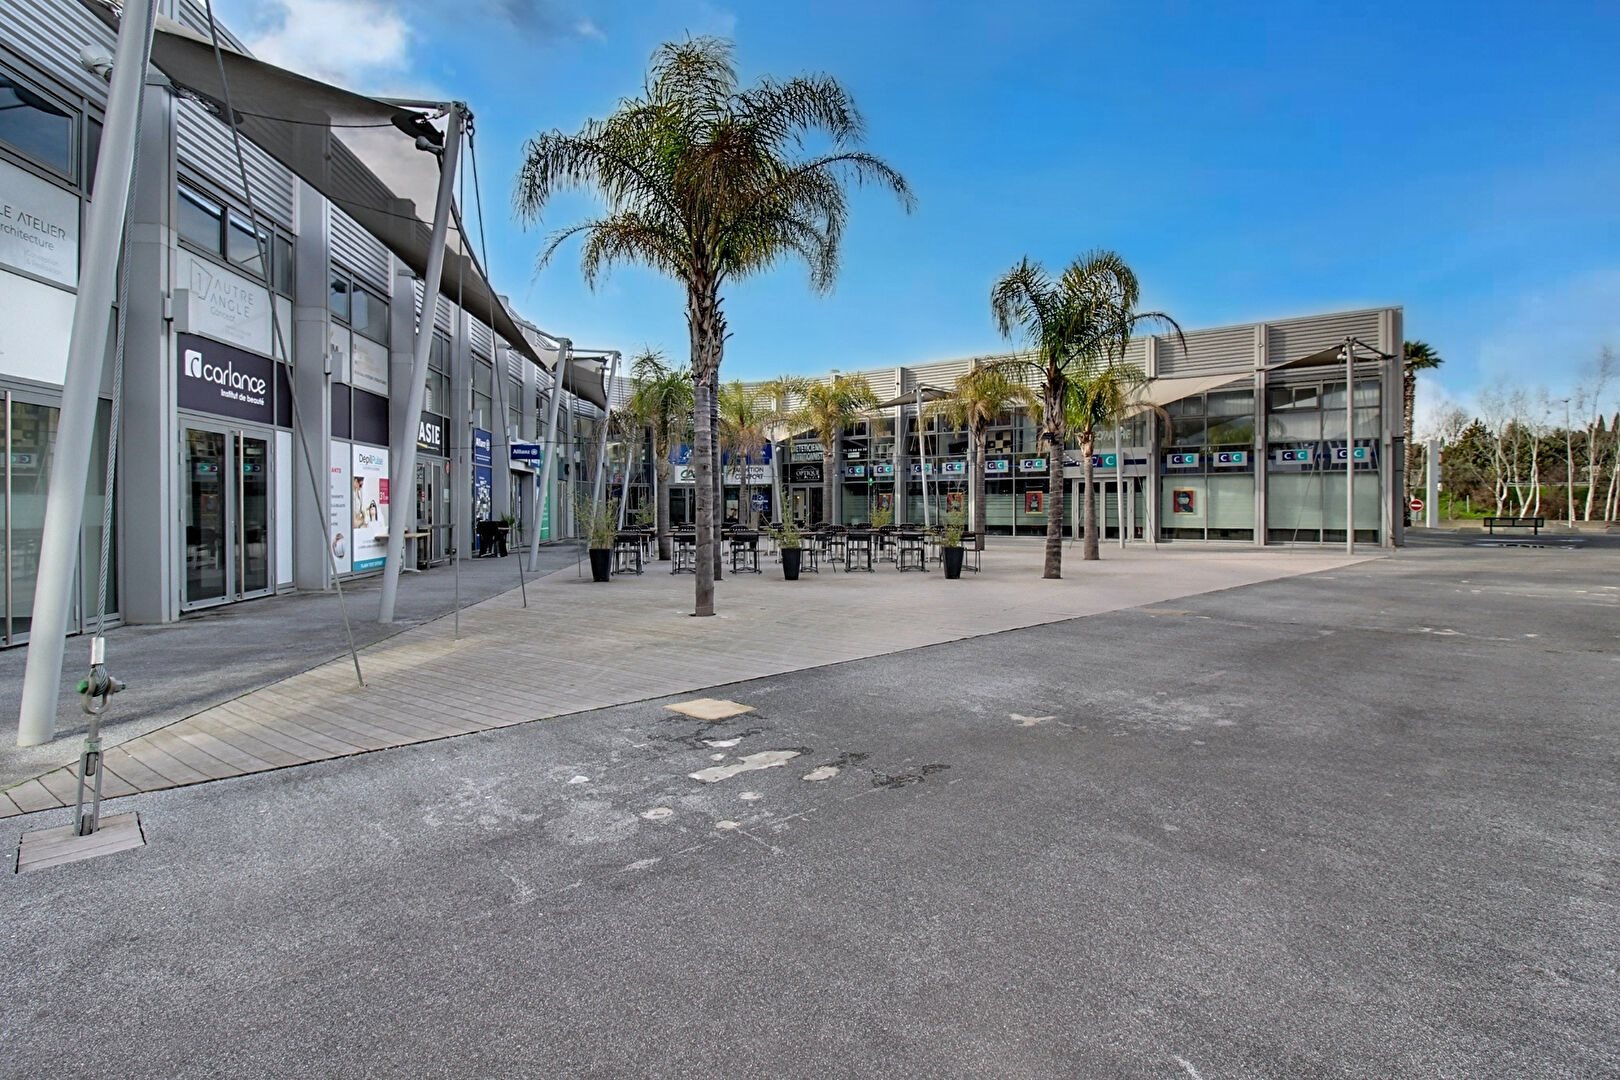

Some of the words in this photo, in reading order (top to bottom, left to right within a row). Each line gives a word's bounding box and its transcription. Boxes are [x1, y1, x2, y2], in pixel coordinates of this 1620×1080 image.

[17, 211, 66, 241] ATELIER
[214, 279, 254, 306] AUTRE
[210, 293, 250, 319] ANGLE
[203, 361, 266, 395] carlance
[239, 394, 246, 402] de
[418, 421, 441, 445] ASIE
[1339, 450, 1362, 458] CC
